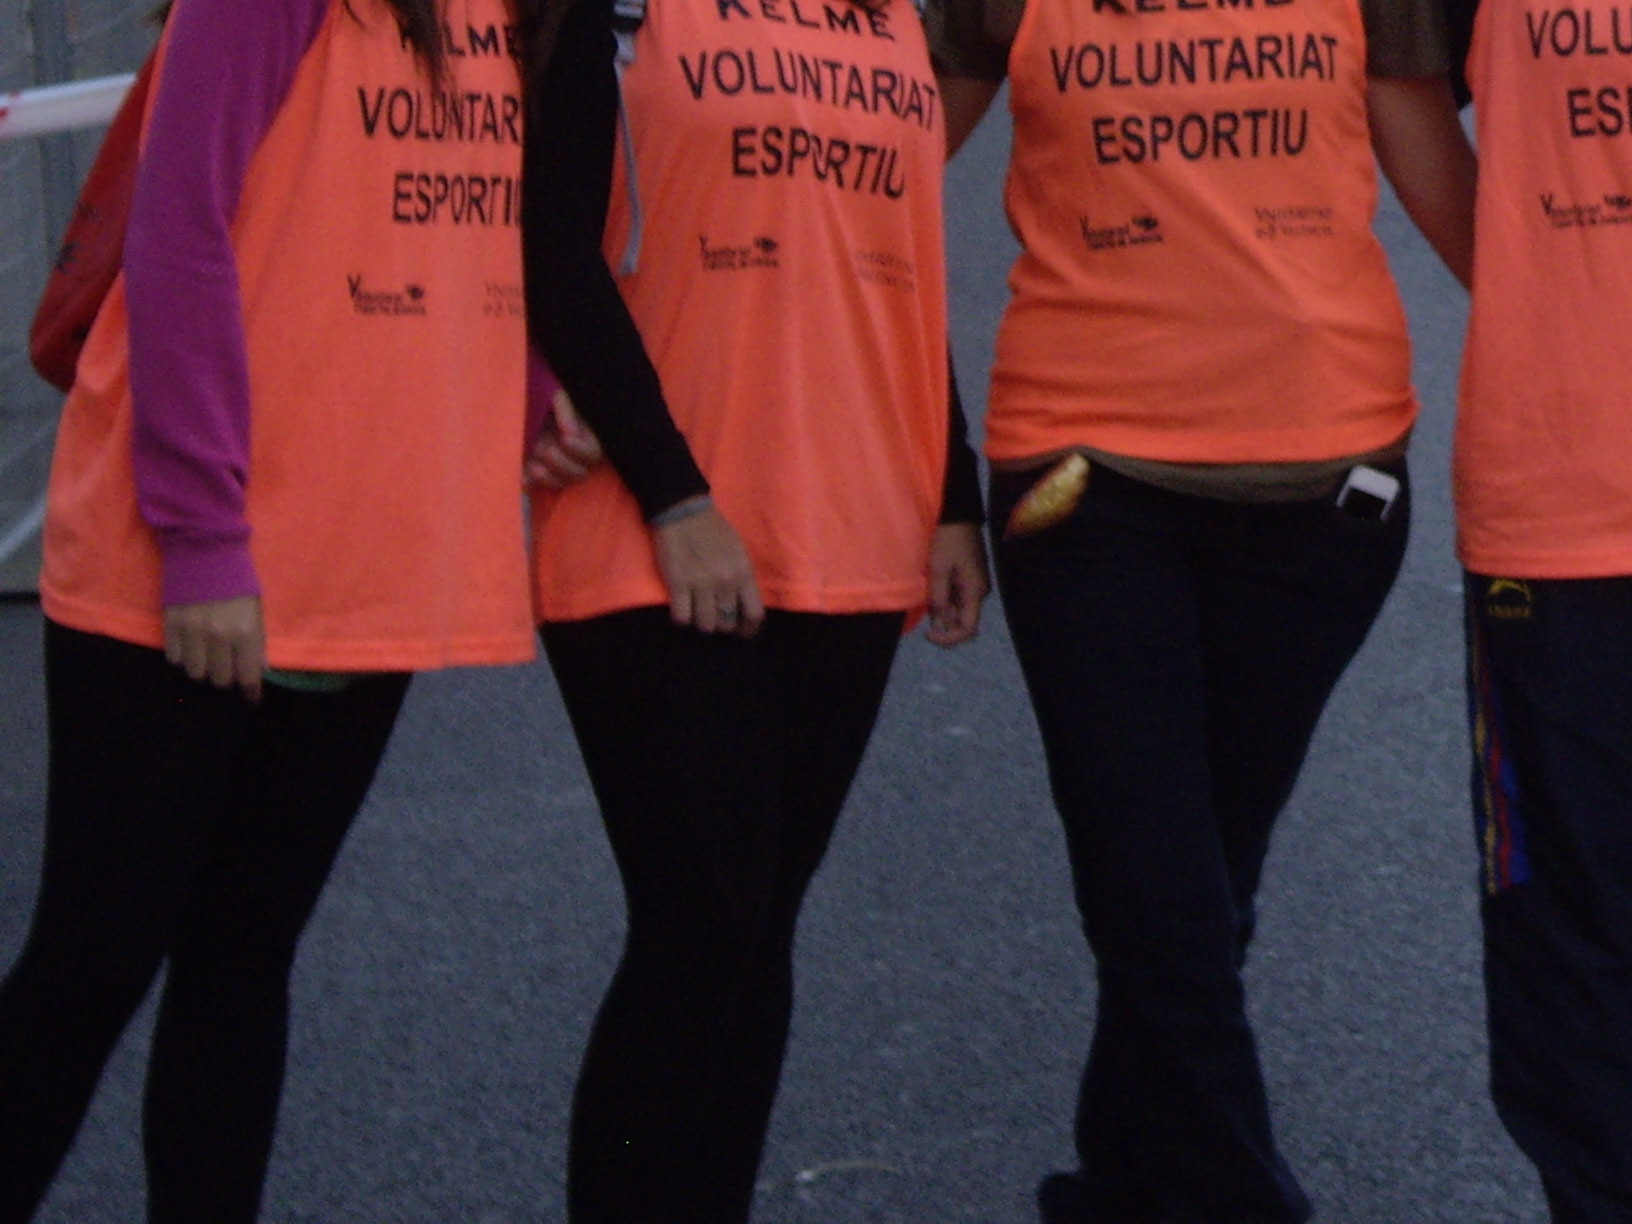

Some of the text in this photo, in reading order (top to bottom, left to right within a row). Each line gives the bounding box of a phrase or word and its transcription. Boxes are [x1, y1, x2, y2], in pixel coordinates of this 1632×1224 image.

[678, 48, 936, 131] VOLUNTARIAT
[1050, 33, 1338, 94] VOLUNTARIAT
[358, 86, 520, 146] VOLUNTAR
[1092, 108, 1308, 164] ESPORTIU
[732, 126, 905, 199] ESPORTIU
